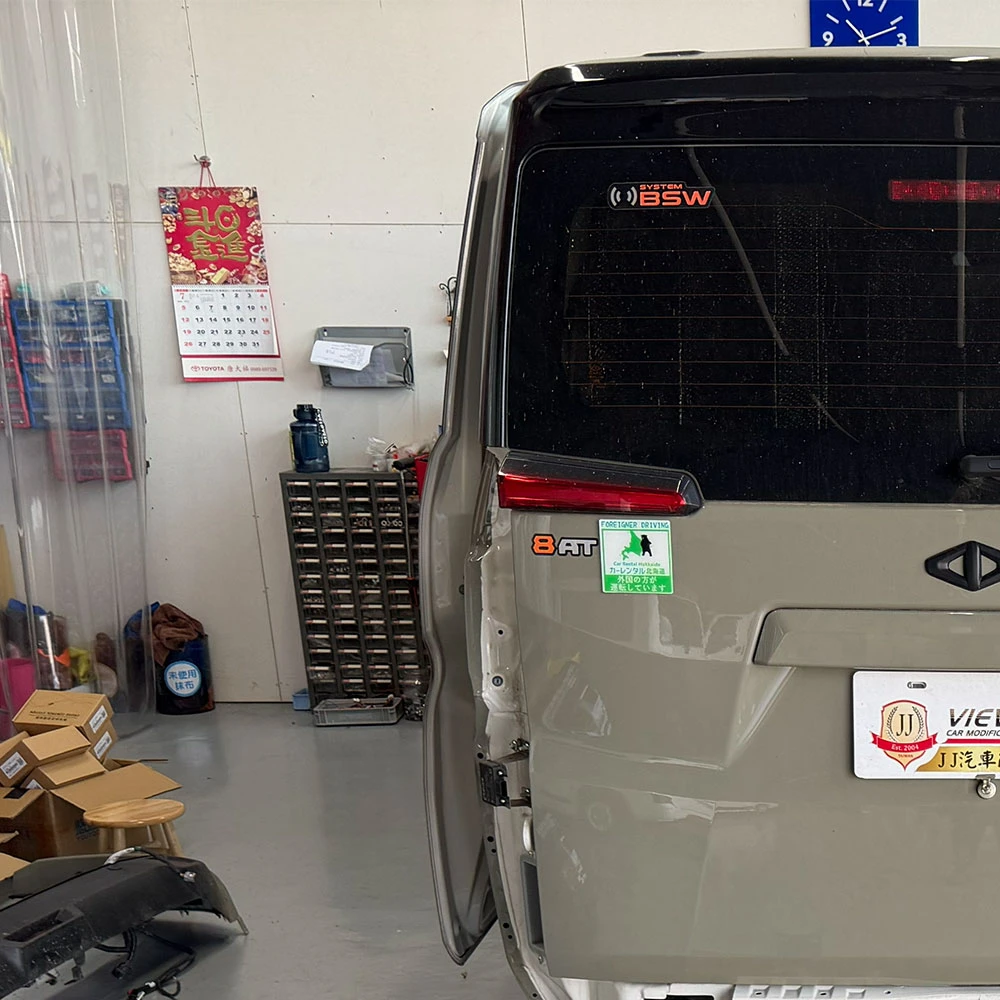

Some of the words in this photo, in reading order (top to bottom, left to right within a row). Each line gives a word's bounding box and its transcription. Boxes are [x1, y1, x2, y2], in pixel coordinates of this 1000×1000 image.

[822, 31, 834, 47] 9
[896, 33, 907, 47] 3
[640, 190, 712, 207] BSW
[601, 521, 638, 529] FOREIGNER
[640, 521, 670, 529] DRIVING
[617, 575, 658, 584] 外国の方が
[168, 669, 198, 680] 未使用
[895, 713, 914, 737] JJ
[946, 729, 964, 737] CAR
[891, 743, 902, 751] Est.
